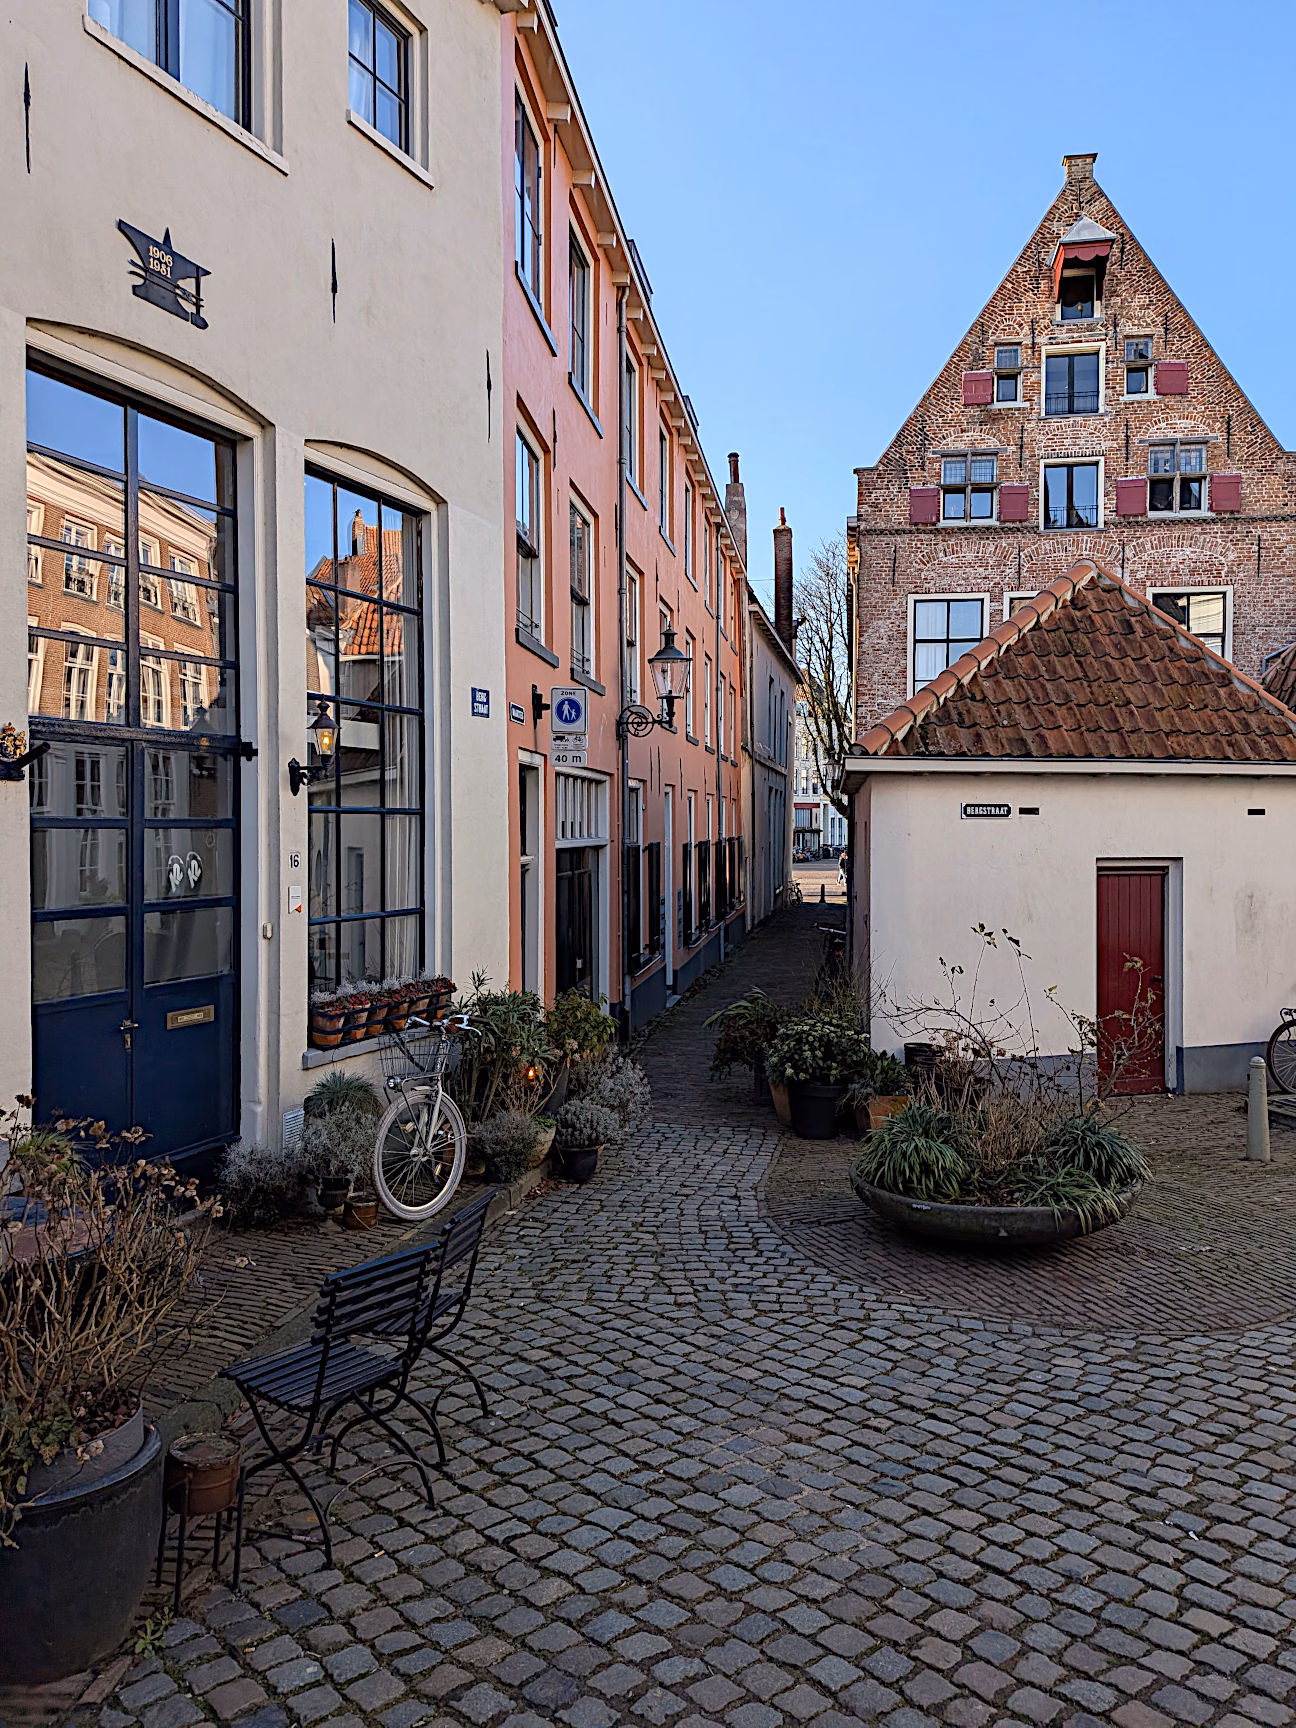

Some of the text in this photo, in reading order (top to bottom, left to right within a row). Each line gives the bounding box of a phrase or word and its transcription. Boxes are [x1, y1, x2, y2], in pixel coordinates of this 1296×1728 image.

[149, 245, 173, 267] 1906
[149, 257, 171, 278] 1981
[554, 754, 582, 763] 40 m
[966, 806, 1008, 815] BERGSTRAAT
[290, 854, 299, 868] 16
